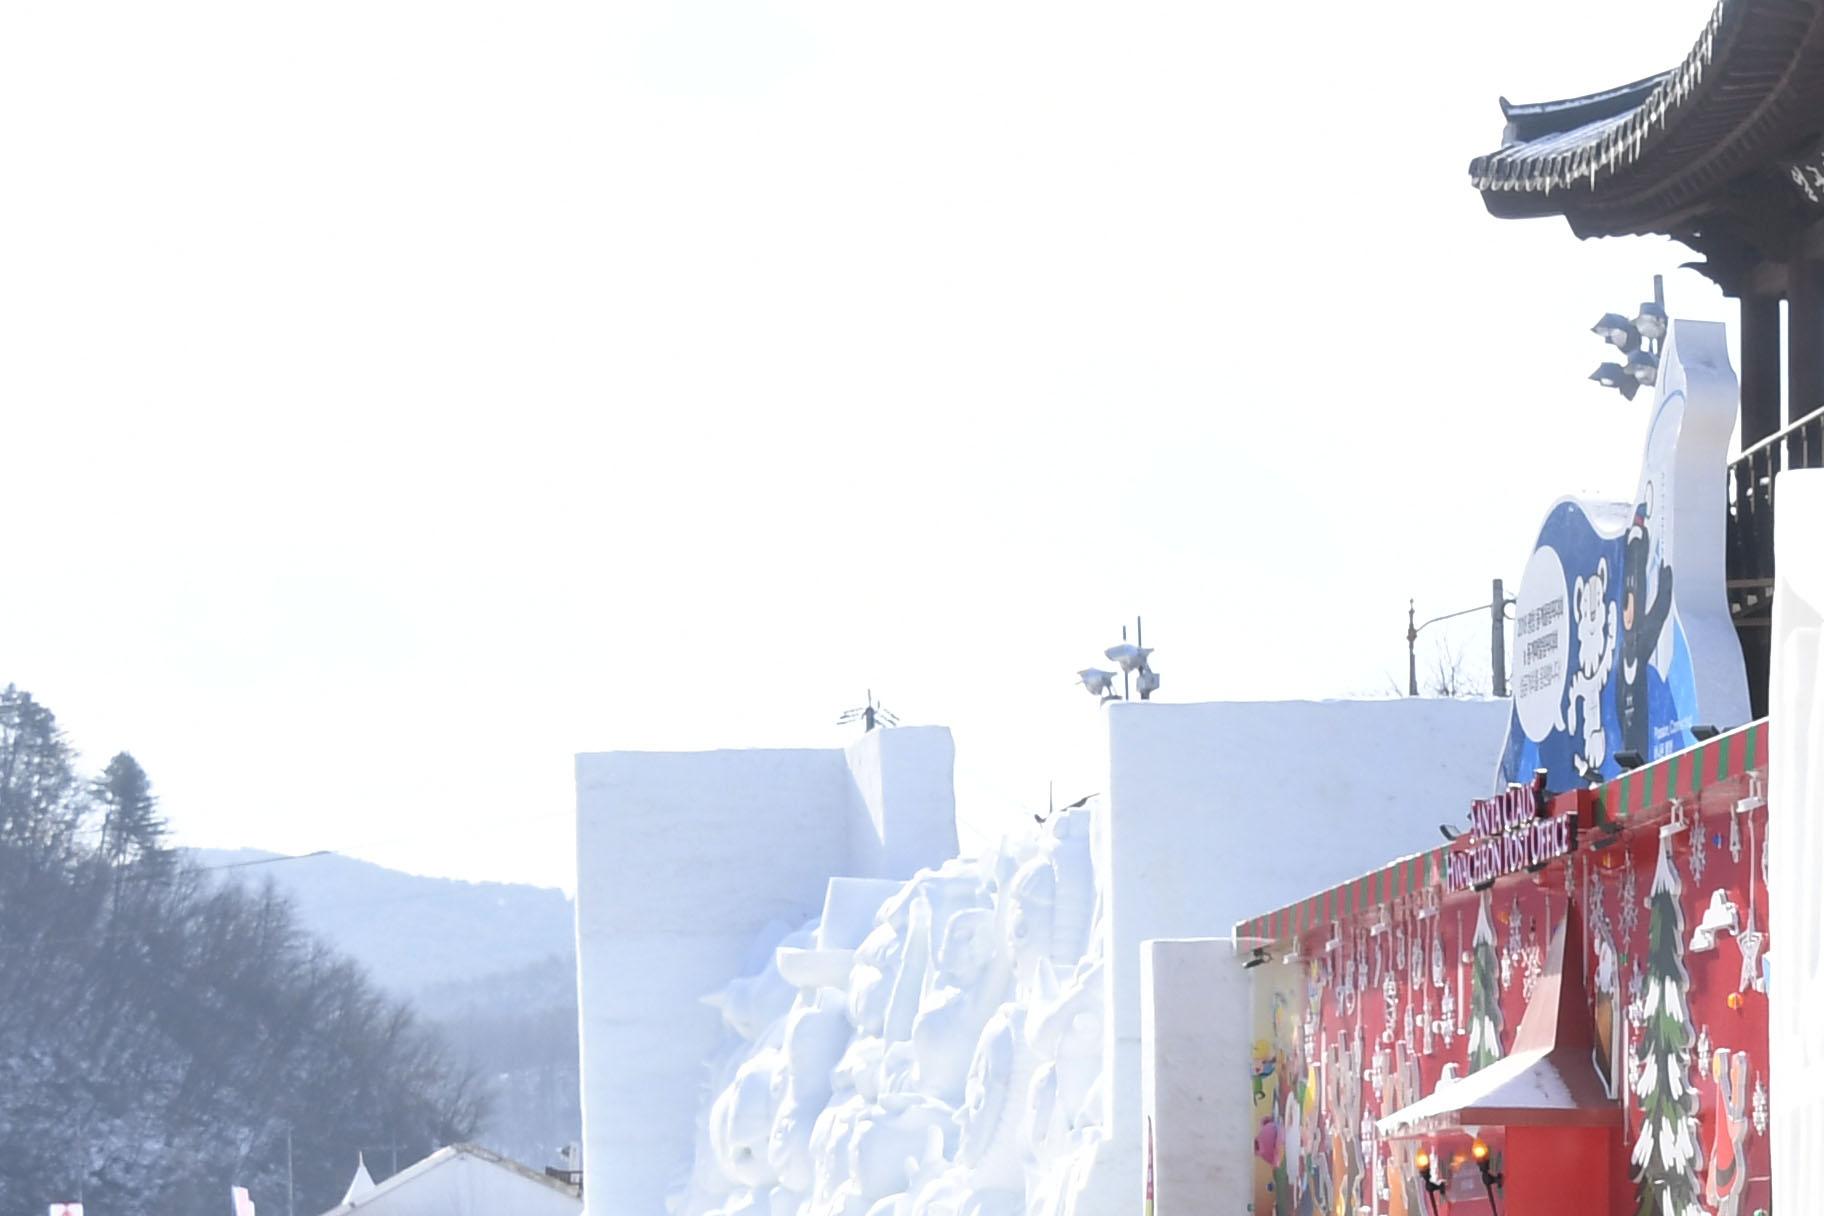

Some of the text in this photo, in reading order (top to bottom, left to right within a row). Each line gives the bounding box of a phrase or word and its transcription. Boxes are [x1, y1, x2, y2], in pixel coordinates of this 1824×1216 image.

[1471, 782, 1536, 842] SANTA CLAUS
[1446, 814, 1568, 893] HWACHEON POST OFFICE
